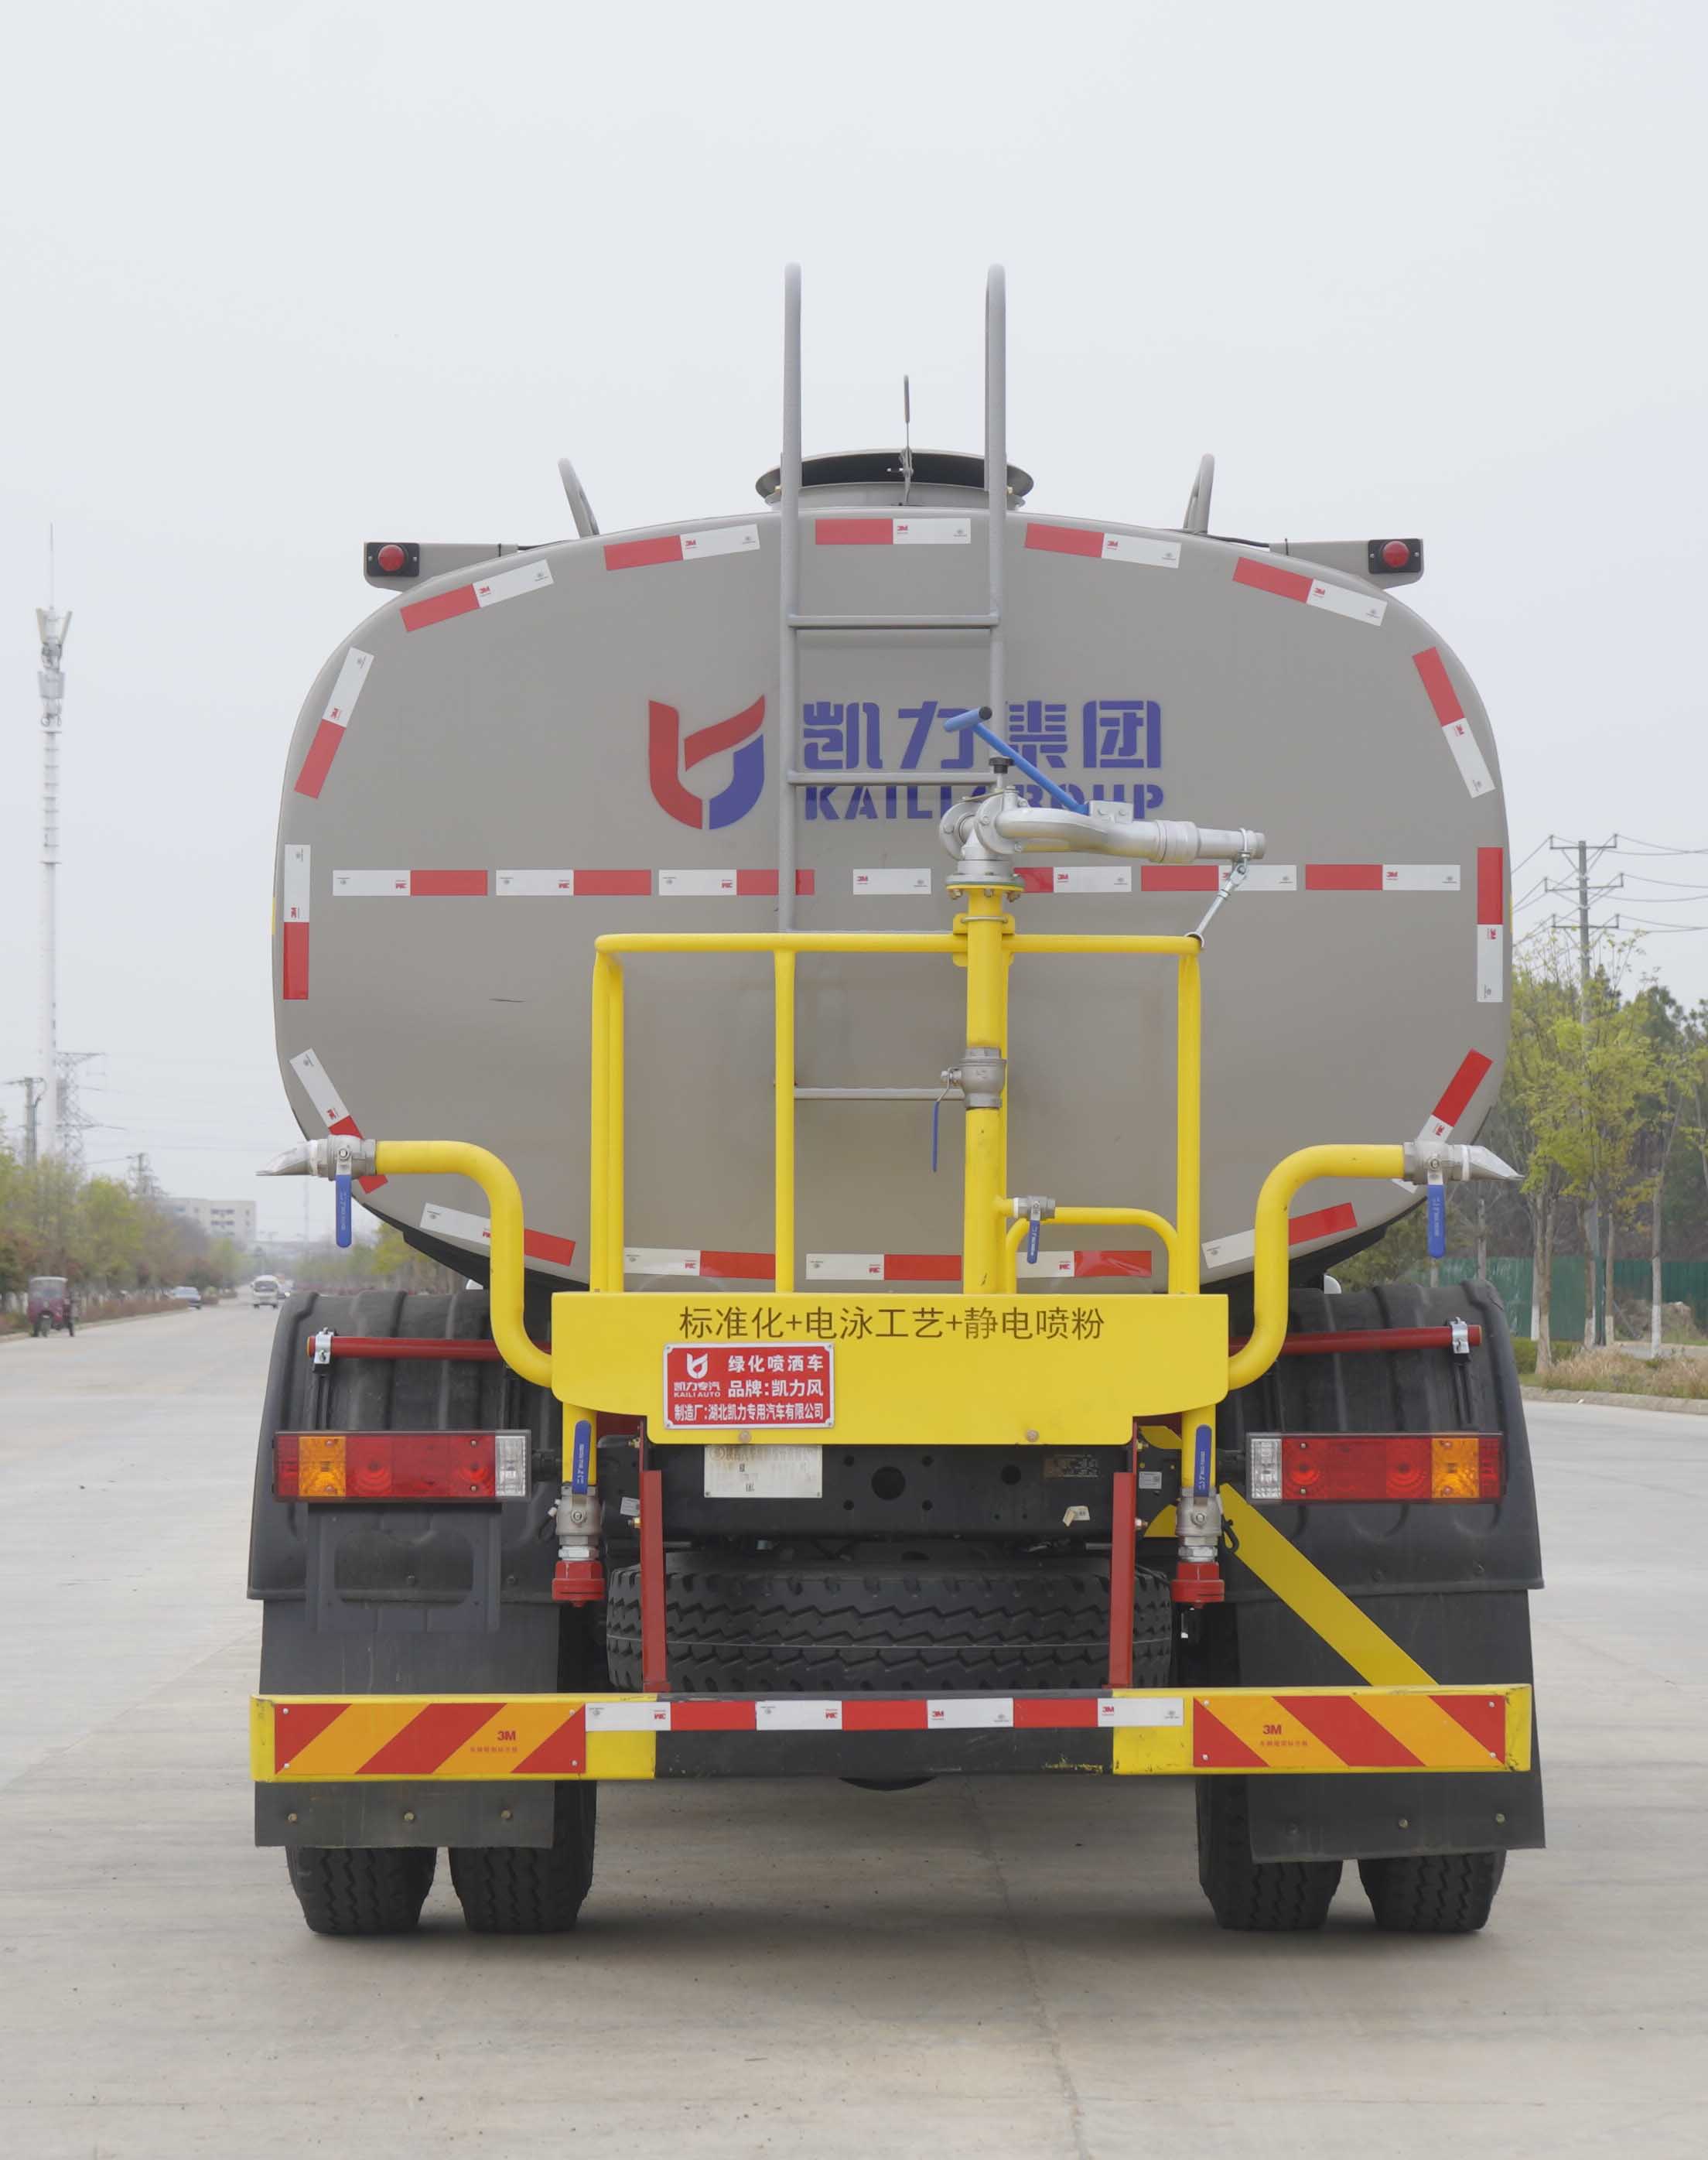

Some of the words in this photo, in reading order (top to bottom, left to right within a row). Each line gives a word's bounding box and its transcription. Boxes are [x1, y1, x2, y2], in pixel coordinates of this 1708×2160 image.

[803, 700, 1161, 770] 凯力集团
[804, 784, 952, 820] KAILI
[972, 784, 1163, 819] ROP
[679, 1305, 1105, 1340] 标准化+电泳工艺+静电喷粉
[728, 1355, 823, 1372] 绿化喷洒车
[497, 1731, 516, 1741] 3M
[1263, 1724, 1282, 1735] 3M
